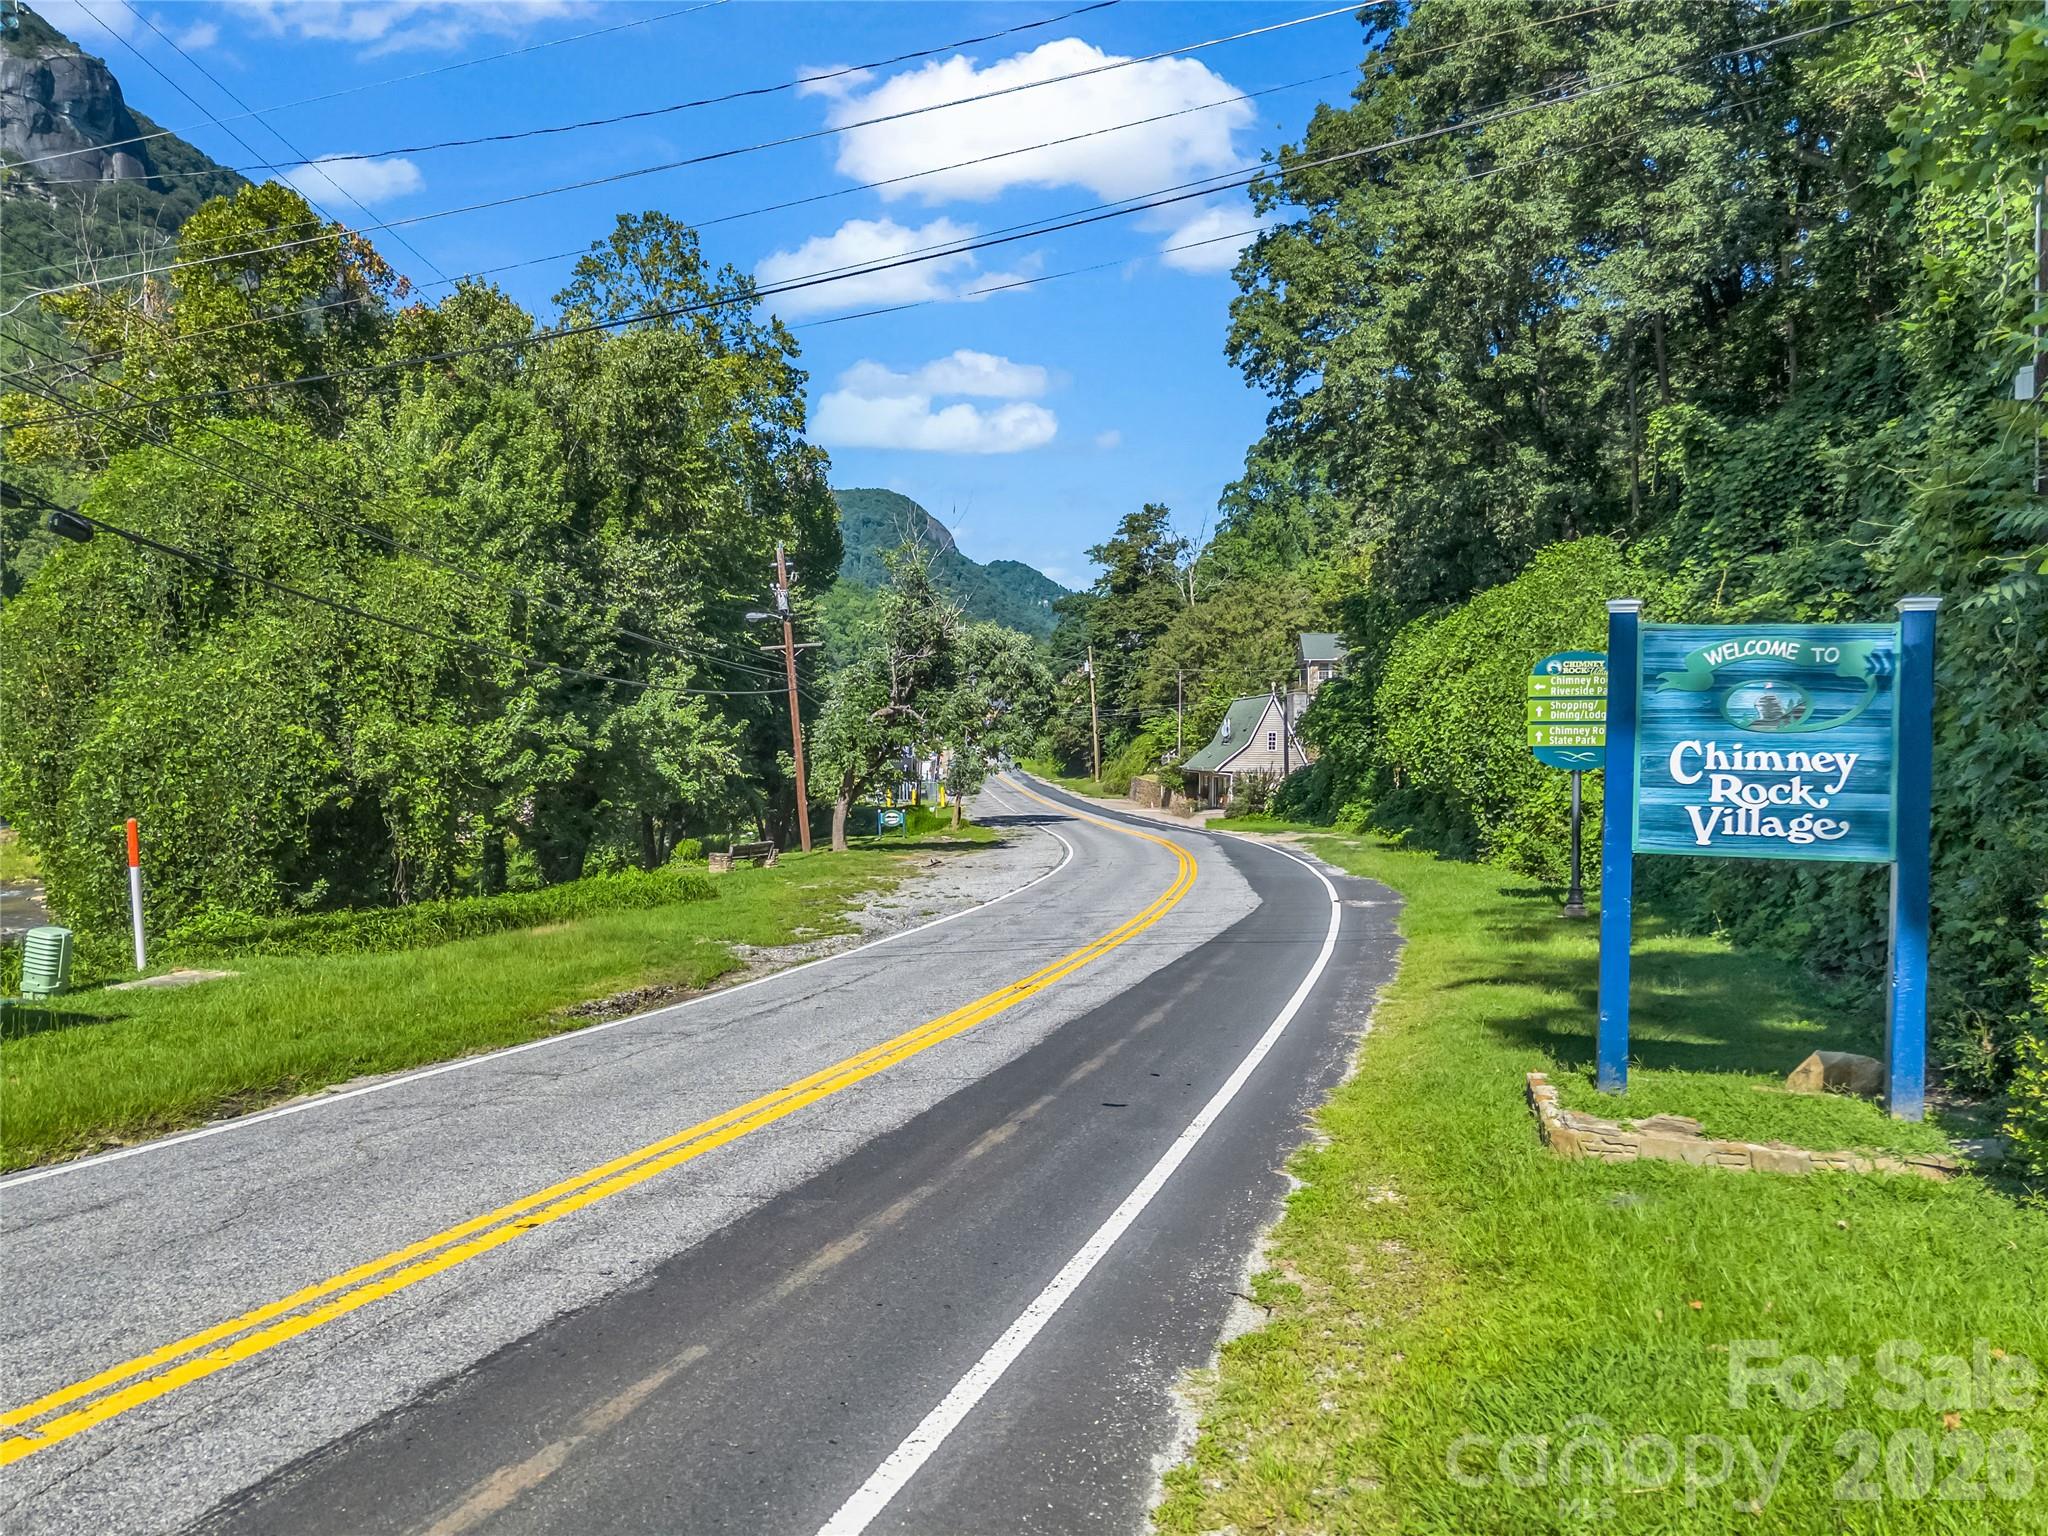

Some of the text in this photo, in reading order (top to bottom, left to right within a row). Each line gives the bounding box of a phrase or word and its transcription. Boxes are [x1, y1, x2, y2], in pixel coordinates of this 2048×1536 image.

[1703, 639, 1840, 666] WELCOME TO
[1550, 676, 1606, 688] Chimney Ro
[1550, 686, 1608, 695] Riverside Pa
[1550, 701, 1598, 711] Shopping/
[1550, 710, 1607, 720] Dining/Lodg
[1549, 727, 1604, 737] Chimney Ro
[1549, 735, 1596, 745] State Park
[1669, 740, 1859, 795] Chimney
[1708, 774, 1829, 809] Rock
[1684, 805, 1850, 845] Village
